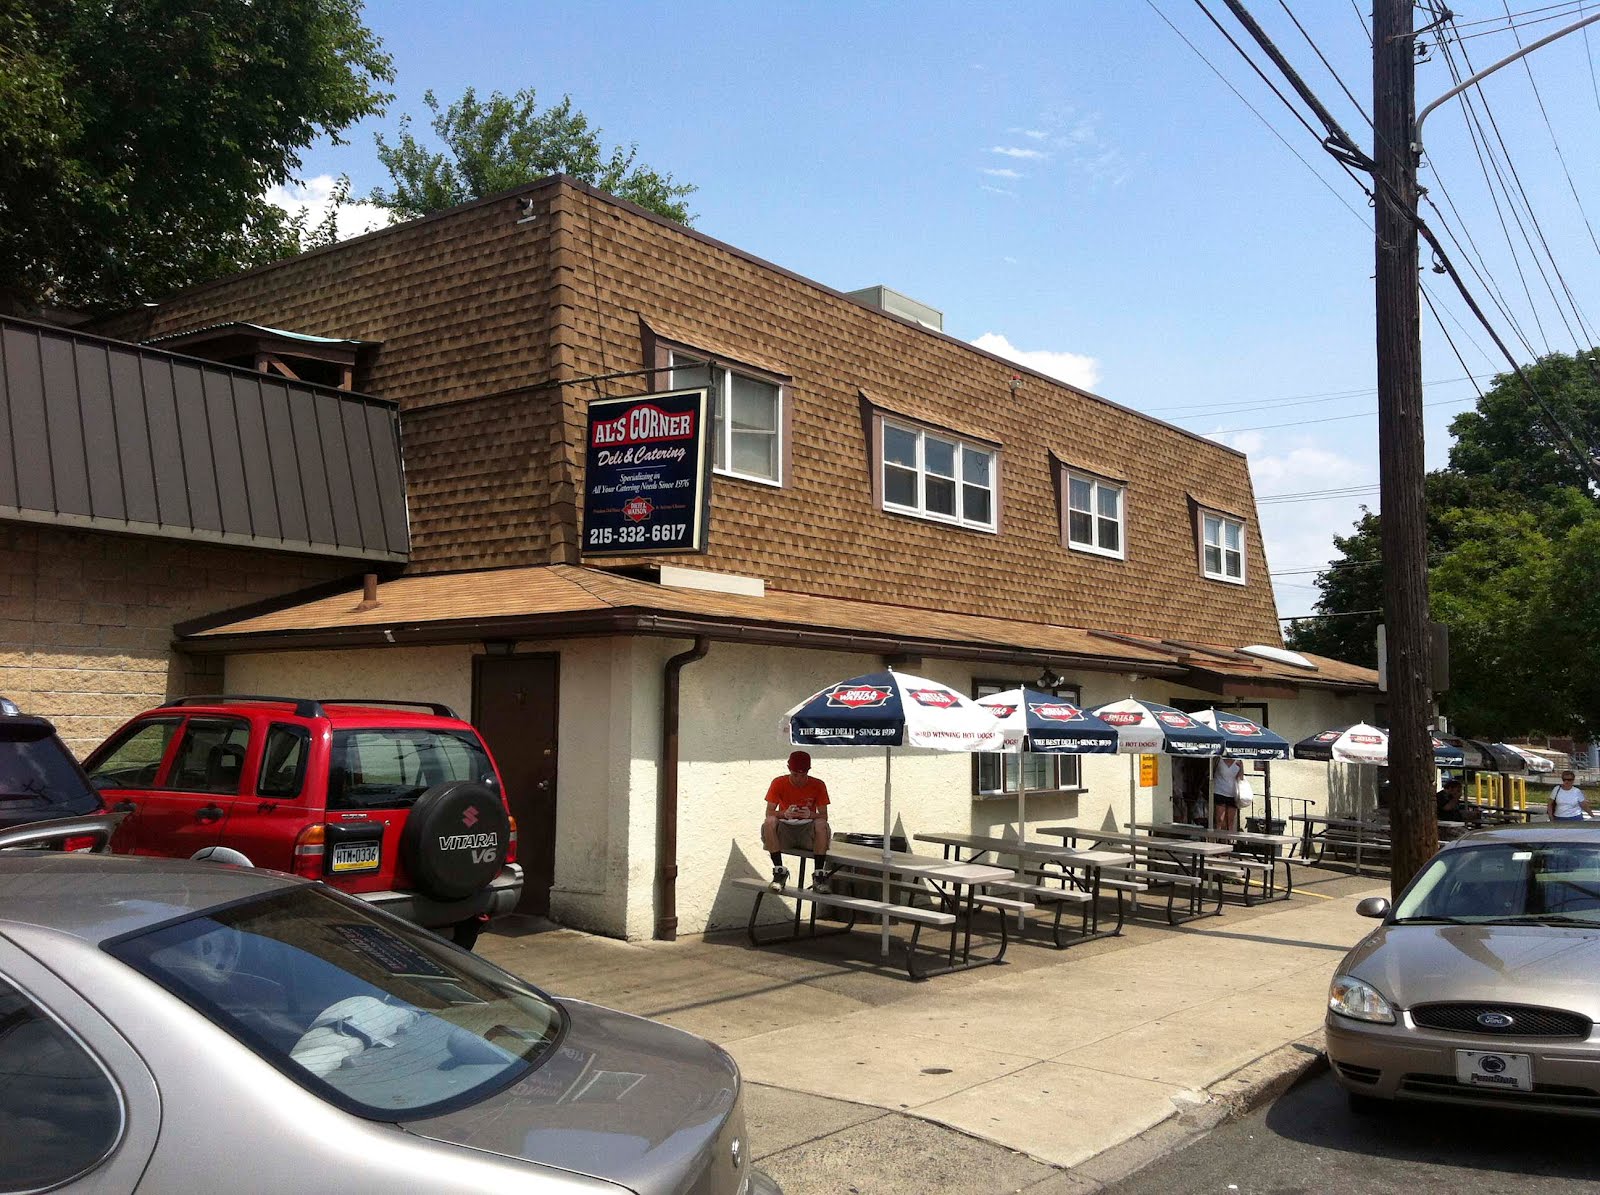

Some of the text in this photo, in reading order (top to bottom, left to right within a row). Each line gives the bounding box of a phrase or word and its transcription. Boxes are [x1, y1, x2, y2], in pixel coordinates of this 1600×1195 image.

[595, 407, 691, 443] AL'S CORNER
[598, 446, 686, 467] Deli & Catering
[620, 472, 661, 484] Specializing in
[592, 479, 690, 494] All Your Catering Needs Since 1976
[589, 524, 687, 545] 215-332-6617
[815, 728, 834, 736] BEST
[439, 832, 498, 851] VITARA
[472, 848, 497, 864] V6
[1485, 1016, 1504, 1024] Ford
